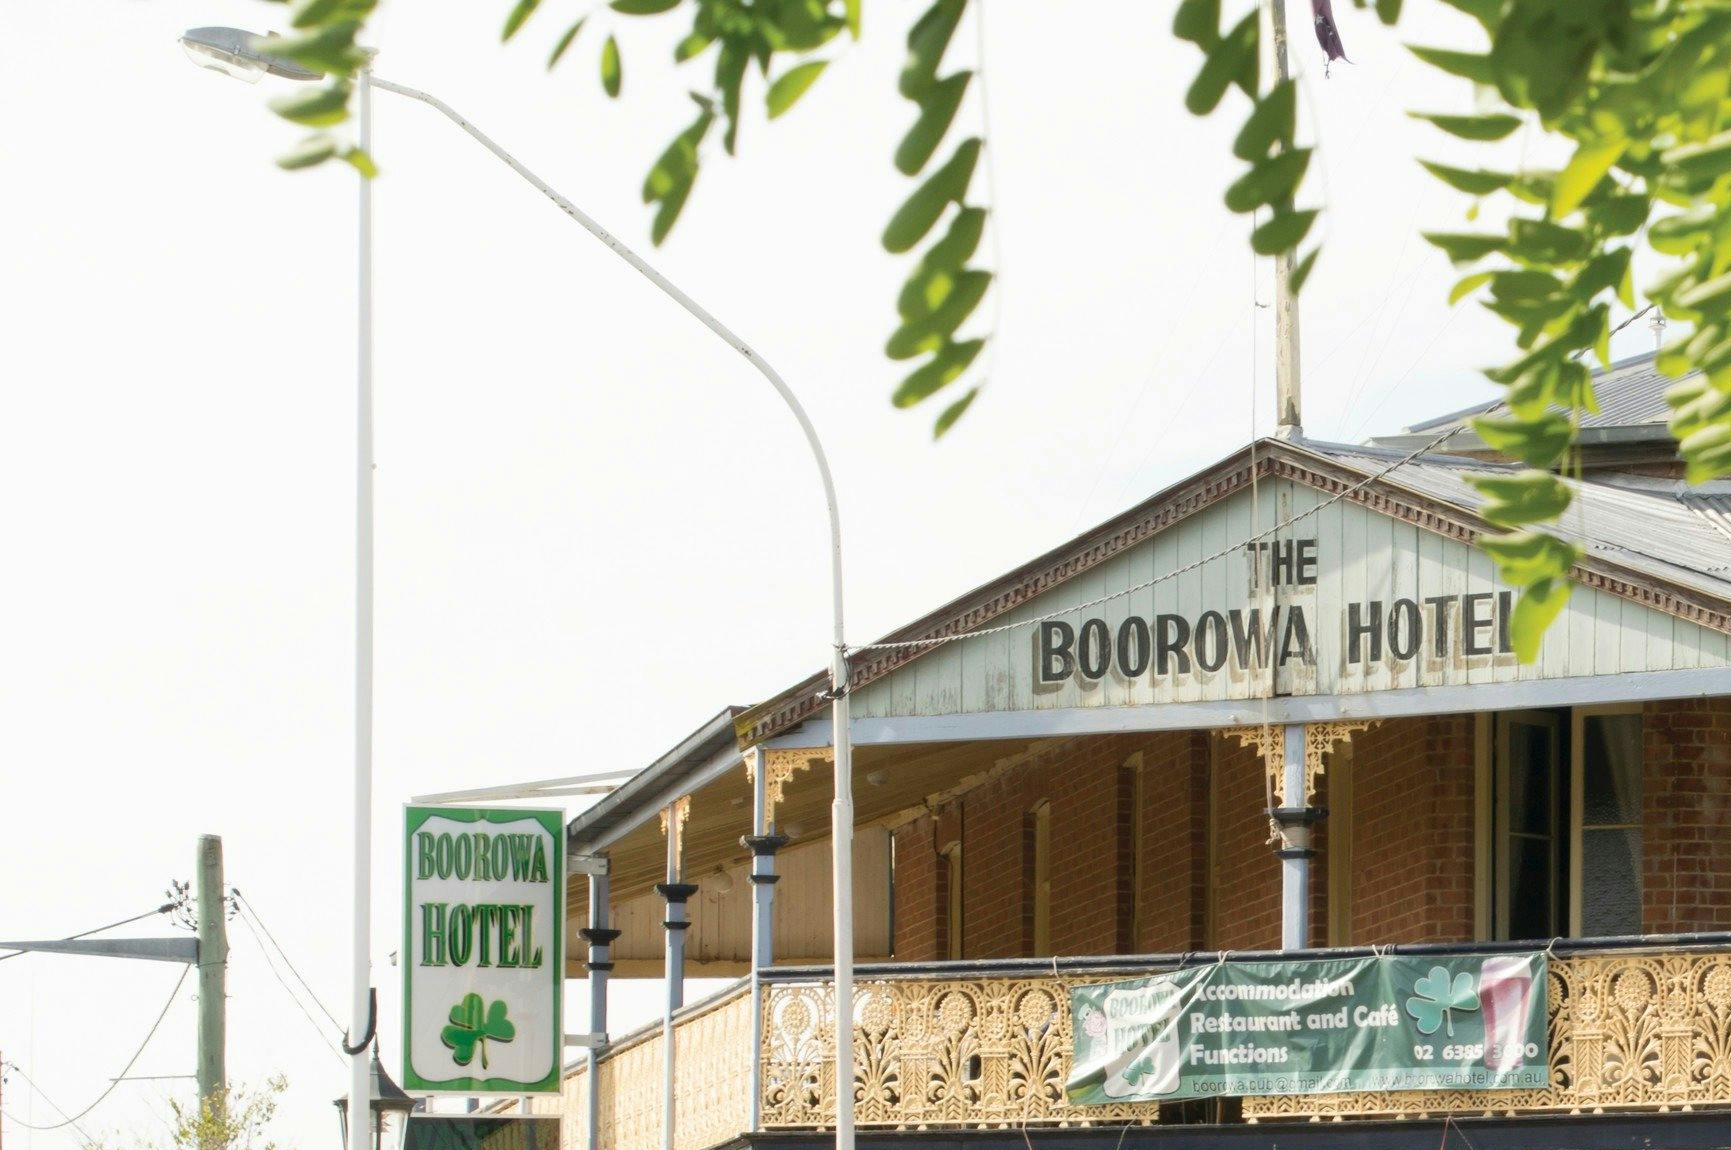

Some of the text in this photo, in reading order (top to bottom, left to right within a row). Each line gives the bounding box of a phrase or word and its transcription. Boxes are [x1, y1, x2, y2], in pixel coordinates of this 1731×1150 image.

[1246, 538, 1318, 592] THE
[1040, 590, 1514, 683] BOOROWA HOTEL
[416, 831, 550, 883] BOOROWA
[420, 903, 543, 968] HOTEL
[1195, 976, 1355, 1002] Accommodation
[1189, 1002, 1399, 1035] Restaurant and Café
[1189, 1042, 1288, 1067] Functions
[1413, 1044, 1434, 1060] 02
